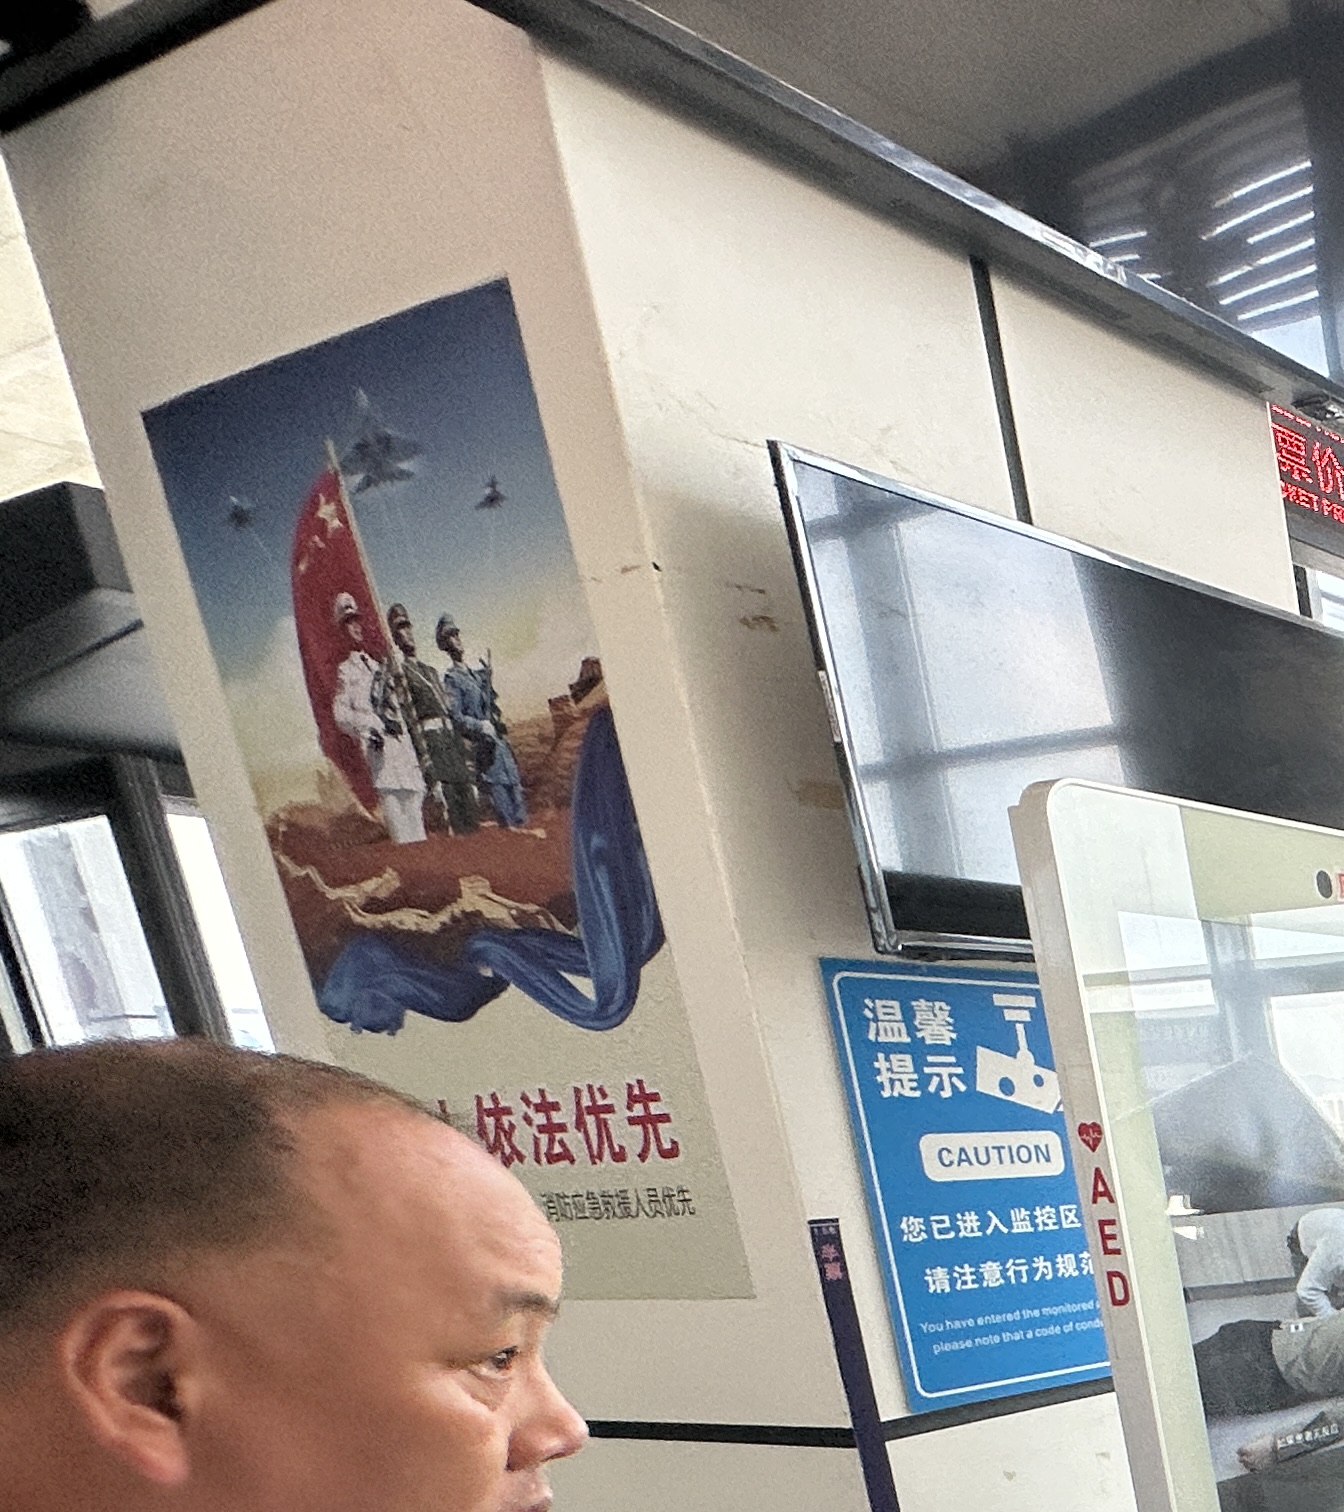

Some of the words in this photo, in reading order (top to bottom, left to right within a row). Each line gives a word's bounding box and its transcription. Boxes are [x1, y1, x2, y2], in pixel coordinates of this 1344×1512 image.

[863, 996, 958, 1047] 温馨
[873, 1052, 967, 1100] 提示
[438, 1078, 681, 1168] 依法优先
[937, 1143, 1052, 1168] CAUTION
[900, 1203, 1082, 1243] 您已进入监控区
[1091, 1166, 1130, 1307] AED
[920, 1322, 944, 1334] You
[945, 1318, 975, 1330] have
[977, 1311, 1021, 1326] entered
[1021, 1308, 1040, 1319] the
[1041, 1300, 1094, 1316] monitored
[933, 1340, 973, 1355] please
[974, 1334, 1000, 1347] note
[1002, 1330, 1024, 1343] that
[1034, 1323, 1061, 1338] code
[1063, 1321, 1074, 1333] of
